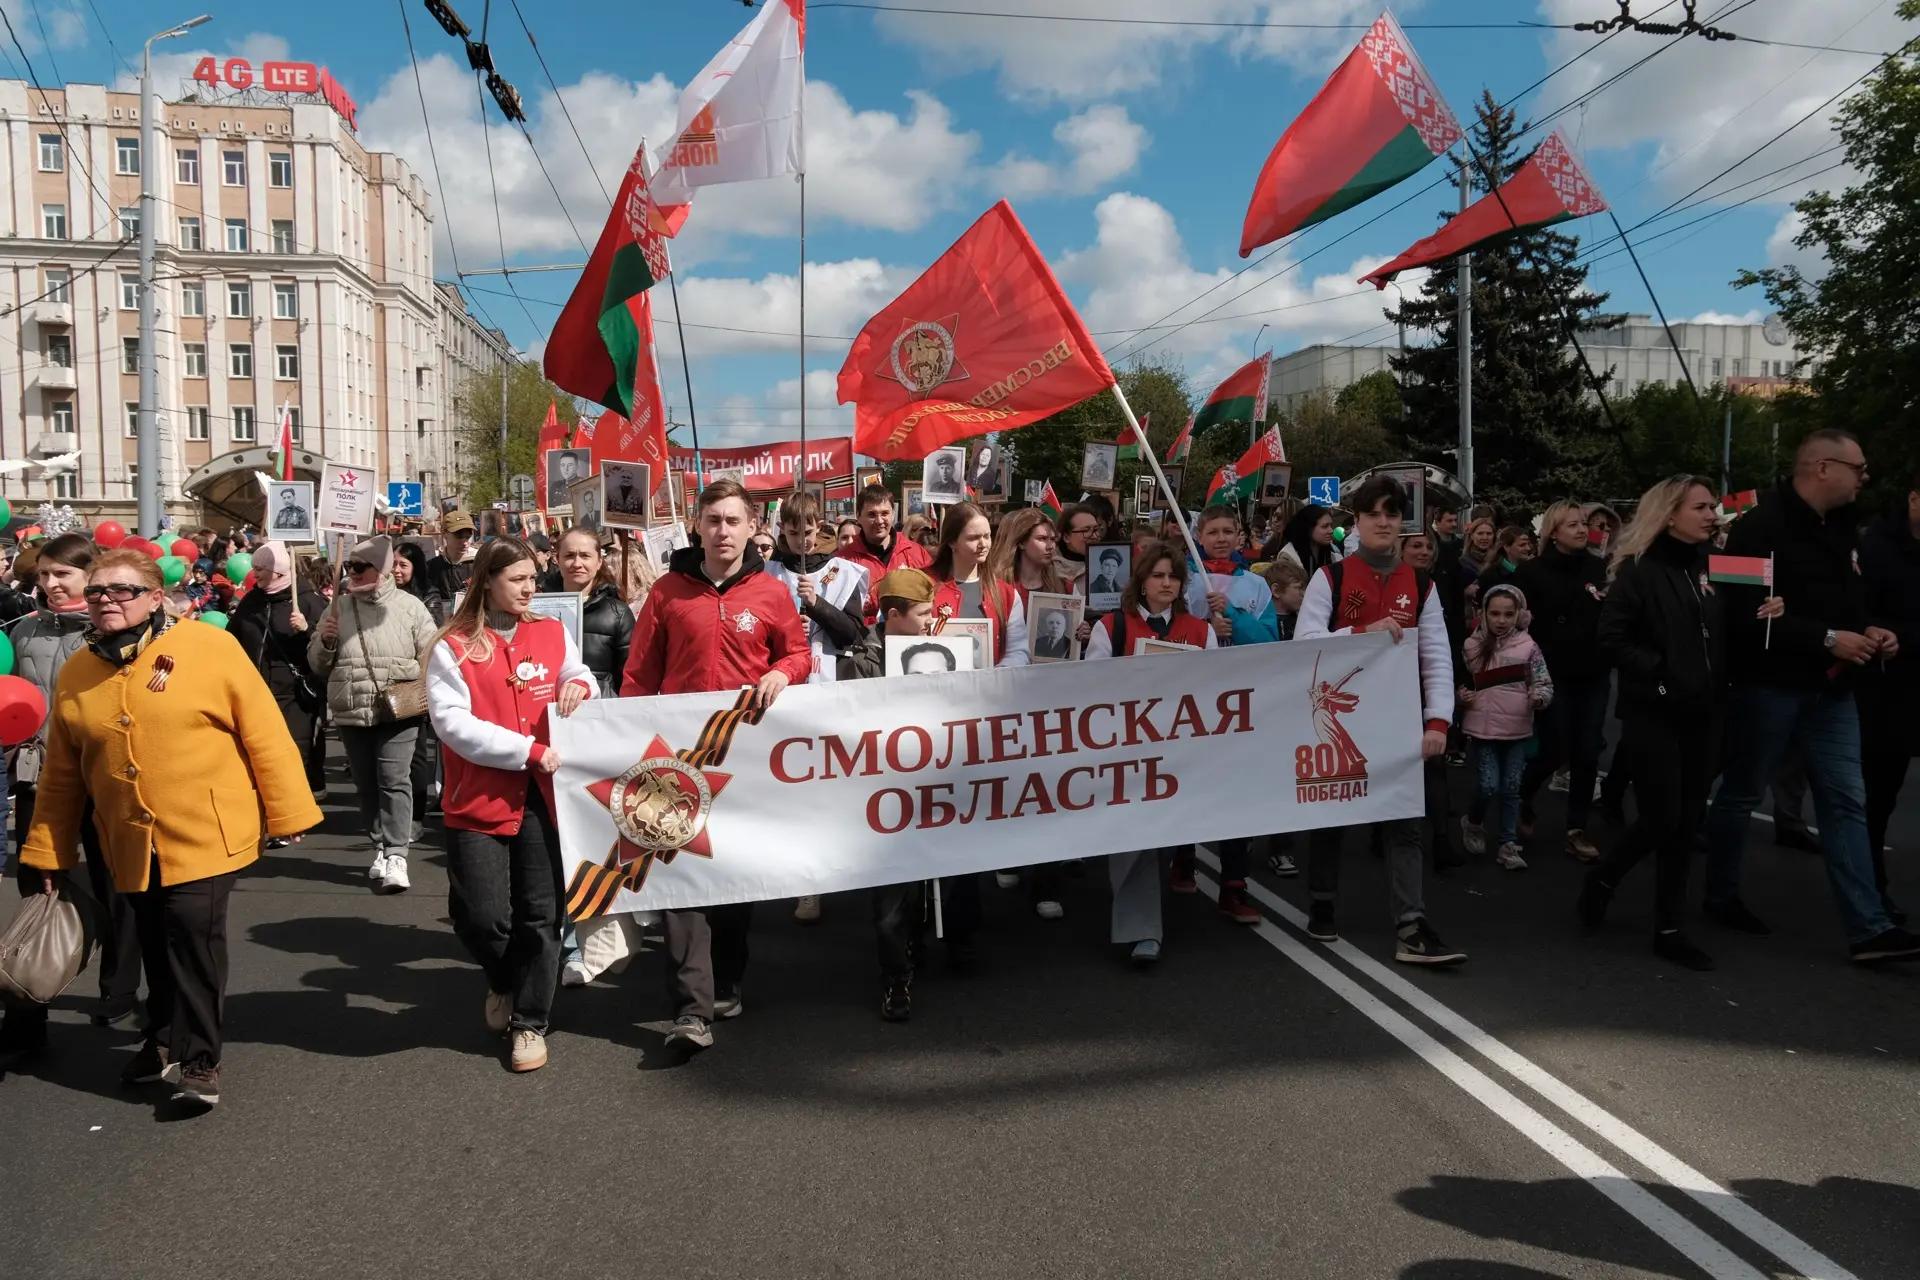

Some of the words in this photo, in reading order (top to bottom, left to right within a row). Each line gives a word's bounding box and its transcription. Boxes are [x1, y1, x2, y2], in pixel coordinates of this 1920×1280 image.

[193, 57, 253, 90] 4G
[271, 68, 309, 86] LTE
[769, 688, 1255, 784] СМОЛЕНСКАЯ
[663, 759, 692, 775] ПОЛК
[1295, 743, 1337, 779] 80
[866, 756, 1179, 834] ОБЛАСТЬ
[1296, 781, 1368, 804] ПОБЕДА!
